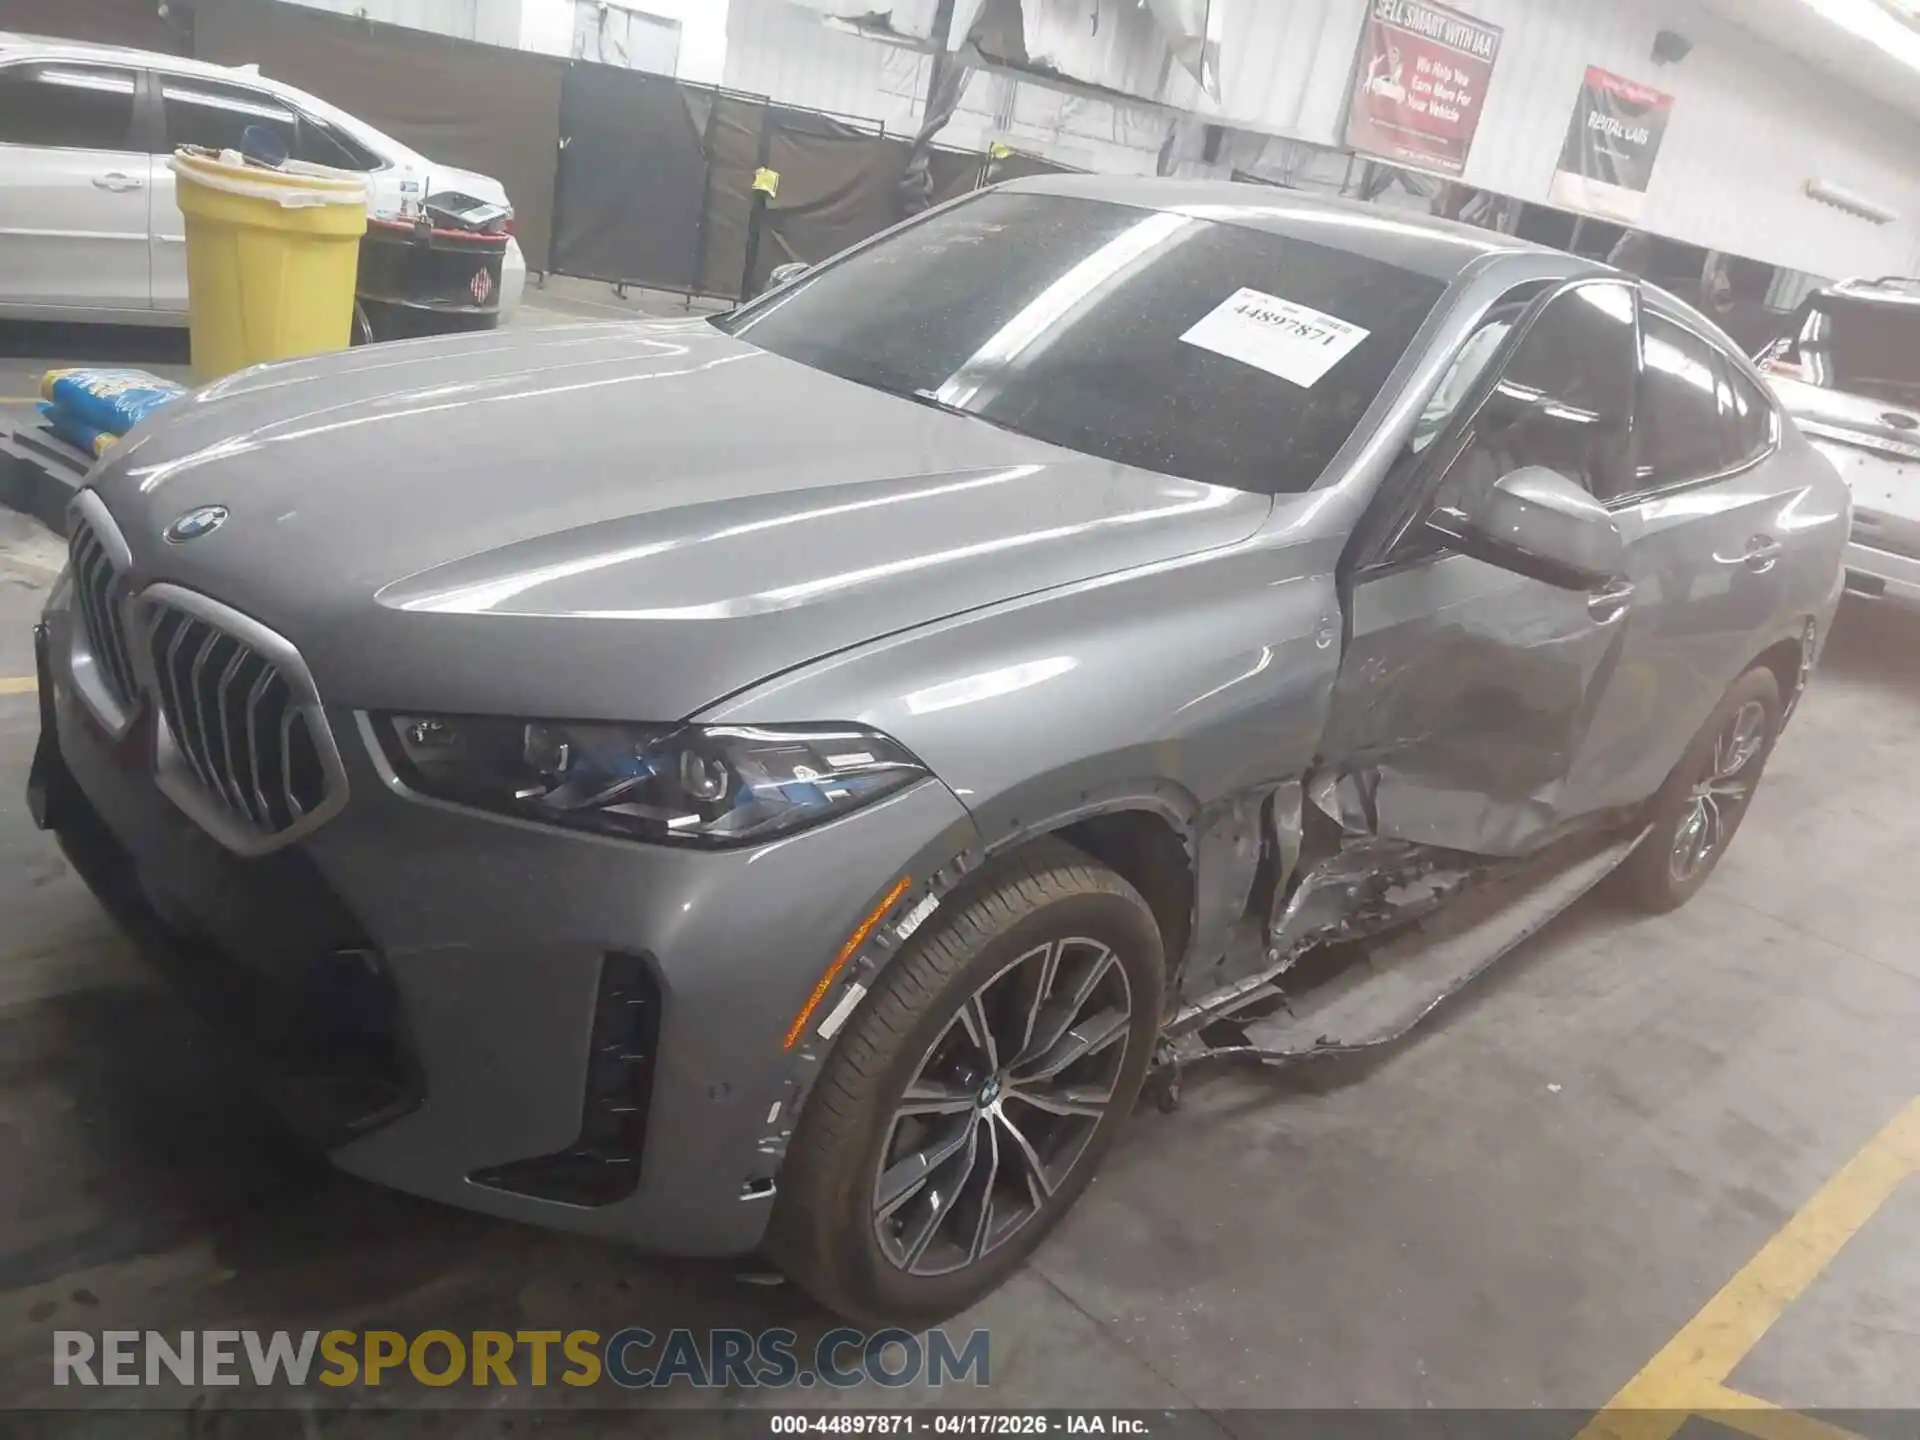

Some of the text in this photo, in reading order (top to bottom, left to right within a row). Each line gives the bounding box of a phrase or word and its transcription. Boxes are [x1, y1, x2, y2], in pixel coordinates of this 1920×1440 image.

[1374, 0, 1492, 57] SELL SMART WITH IAA
[1417, 54, 1469, 87] We Help You
[1408, 92, 1460, 123] Your Vehicle
[1411, 74, 1472, 107] Earn More For
[1588, 110, 1650, 145] RENTAL CARS
[1234, 304, 1336, 346] 44897871
